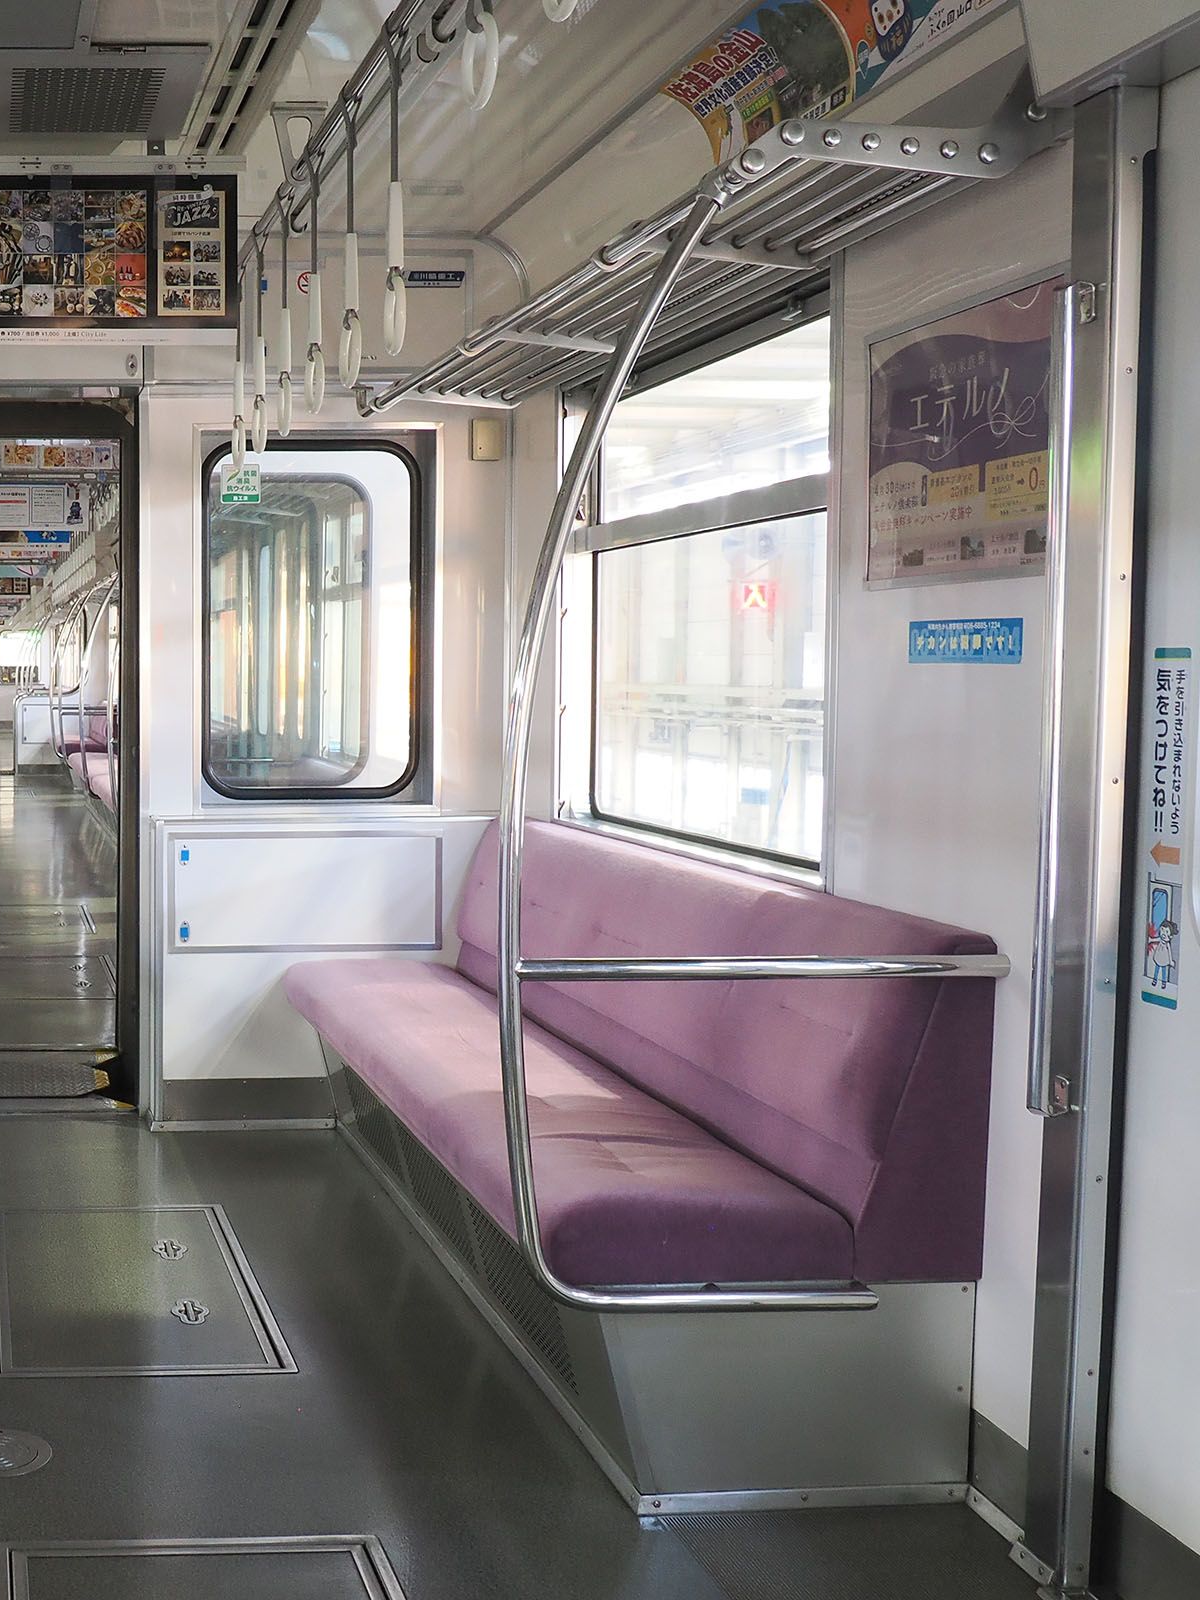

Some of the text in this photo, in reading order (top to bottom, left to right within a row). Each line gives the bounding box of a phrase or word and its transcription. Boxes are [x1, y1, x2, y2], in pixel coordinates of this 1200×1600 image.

[665, 29, 767, 104] 佐渡島の金山
[172, 204, 212, 226] JAZZ
[1152, 668, 1172, 833] 気をつけてね!!
[1170, 669, 1186, 835] 手を引き込まれないよう
